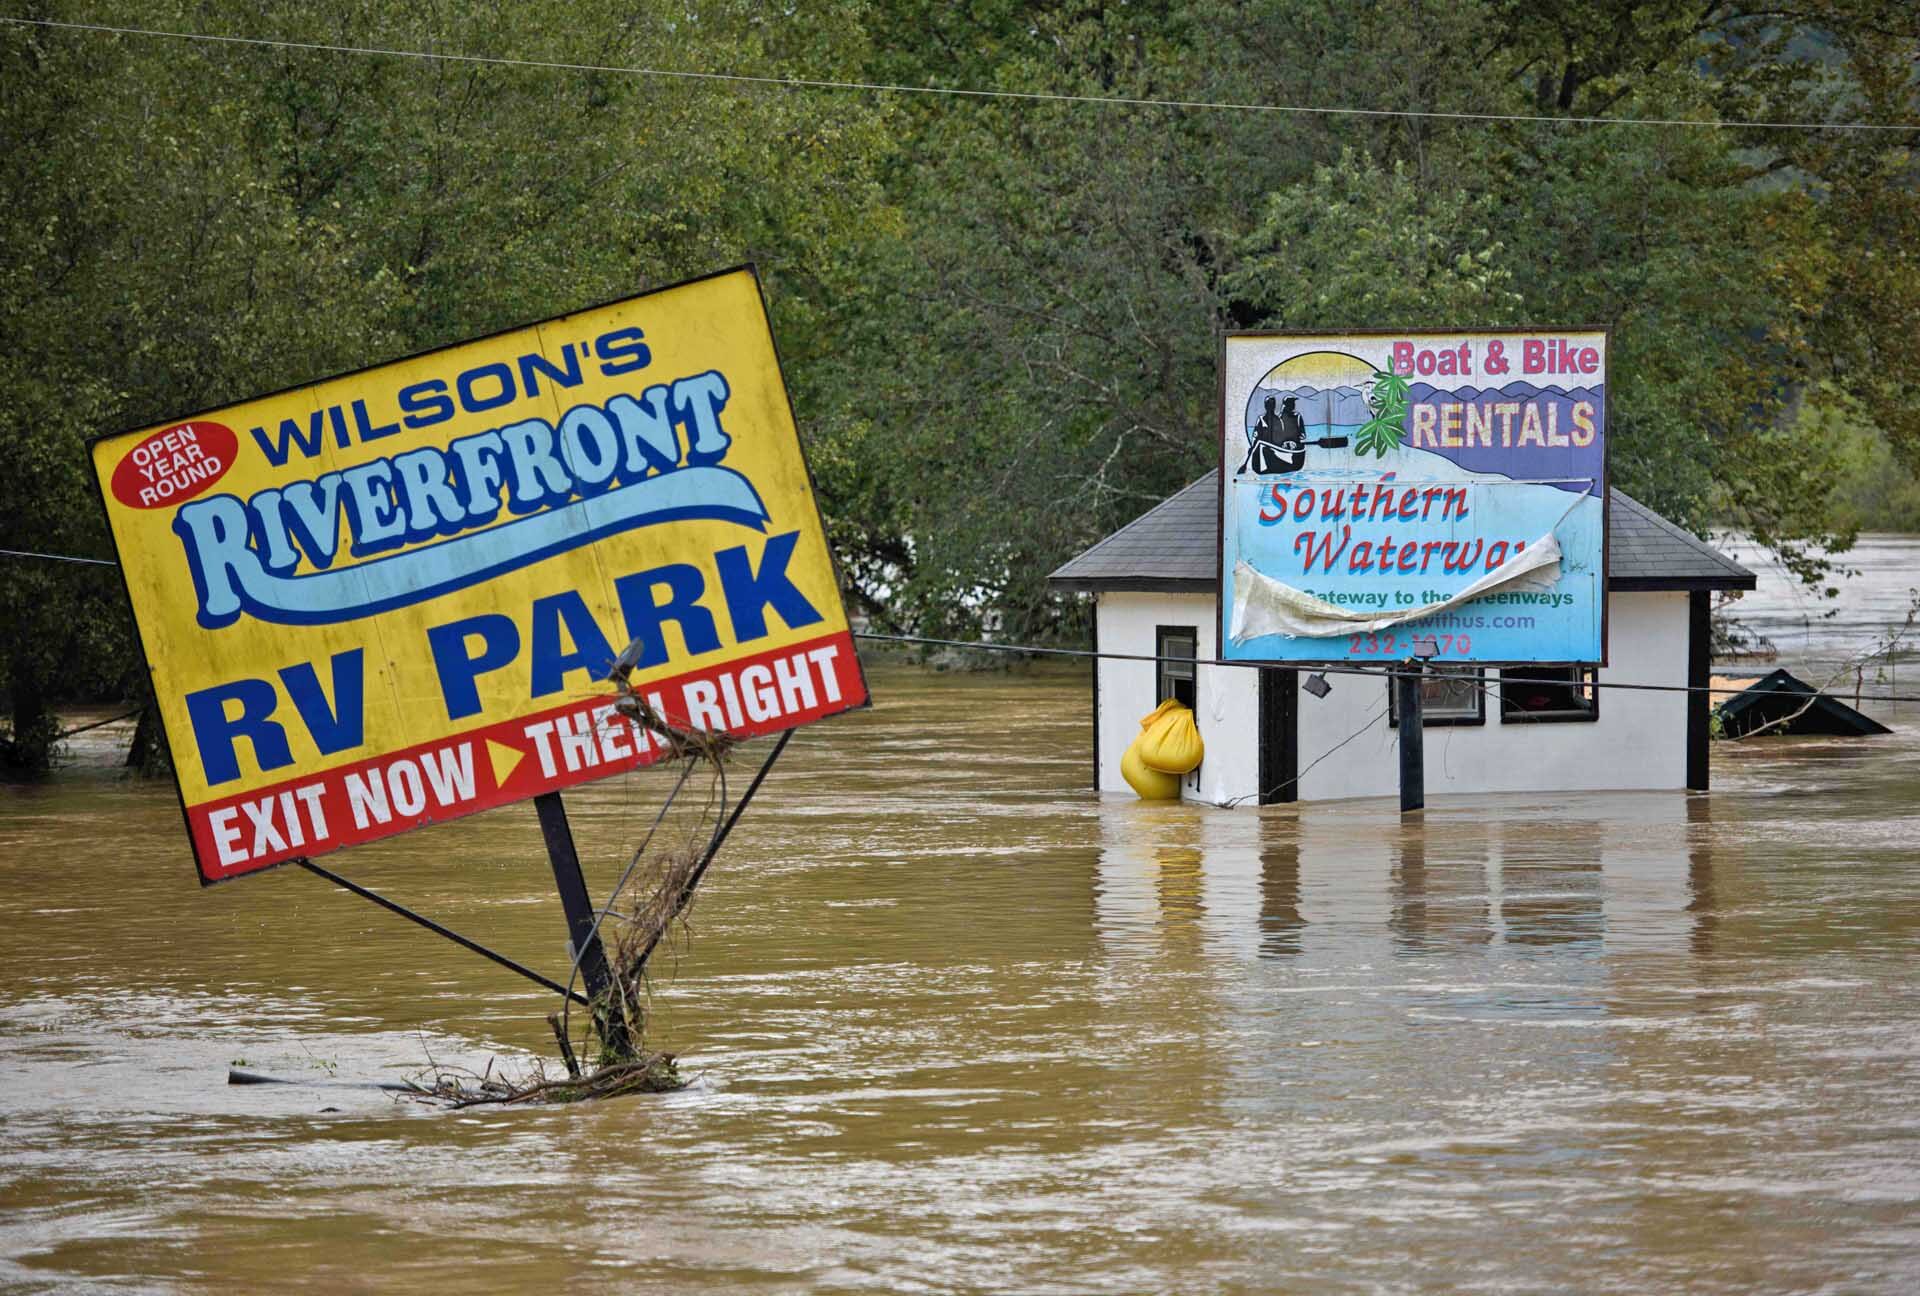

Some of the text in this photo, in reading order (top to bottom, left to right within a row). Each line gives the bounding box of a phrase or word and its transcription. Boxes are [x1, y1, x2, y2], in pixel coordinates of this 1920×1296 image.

[1393, 340, 1600, 376] Boat & Bike
[250, 327, 652, 467] WILSON'S
[132, 425, 198, 466] OPEN
[1412, 400, 1596, 449] RENTALS
[139, 456, 222, 506] ROUND
[140, 444, 205, 483] YEAR
[172, 369, 771, 629] RIVERFRONT
[1259, 472, 1470, 524] Southern
[1303, 589, 1389, 608] ateway
[1395, 590, 1414, 604] to
[1422, 590, 1453, 604] the
[185, 530, 825, 787] RV PARK
[208, 783, 329, 867] EXIT
[344, 742, 477, 830] NOW
[681, 645, 843, 743] RIGHT
